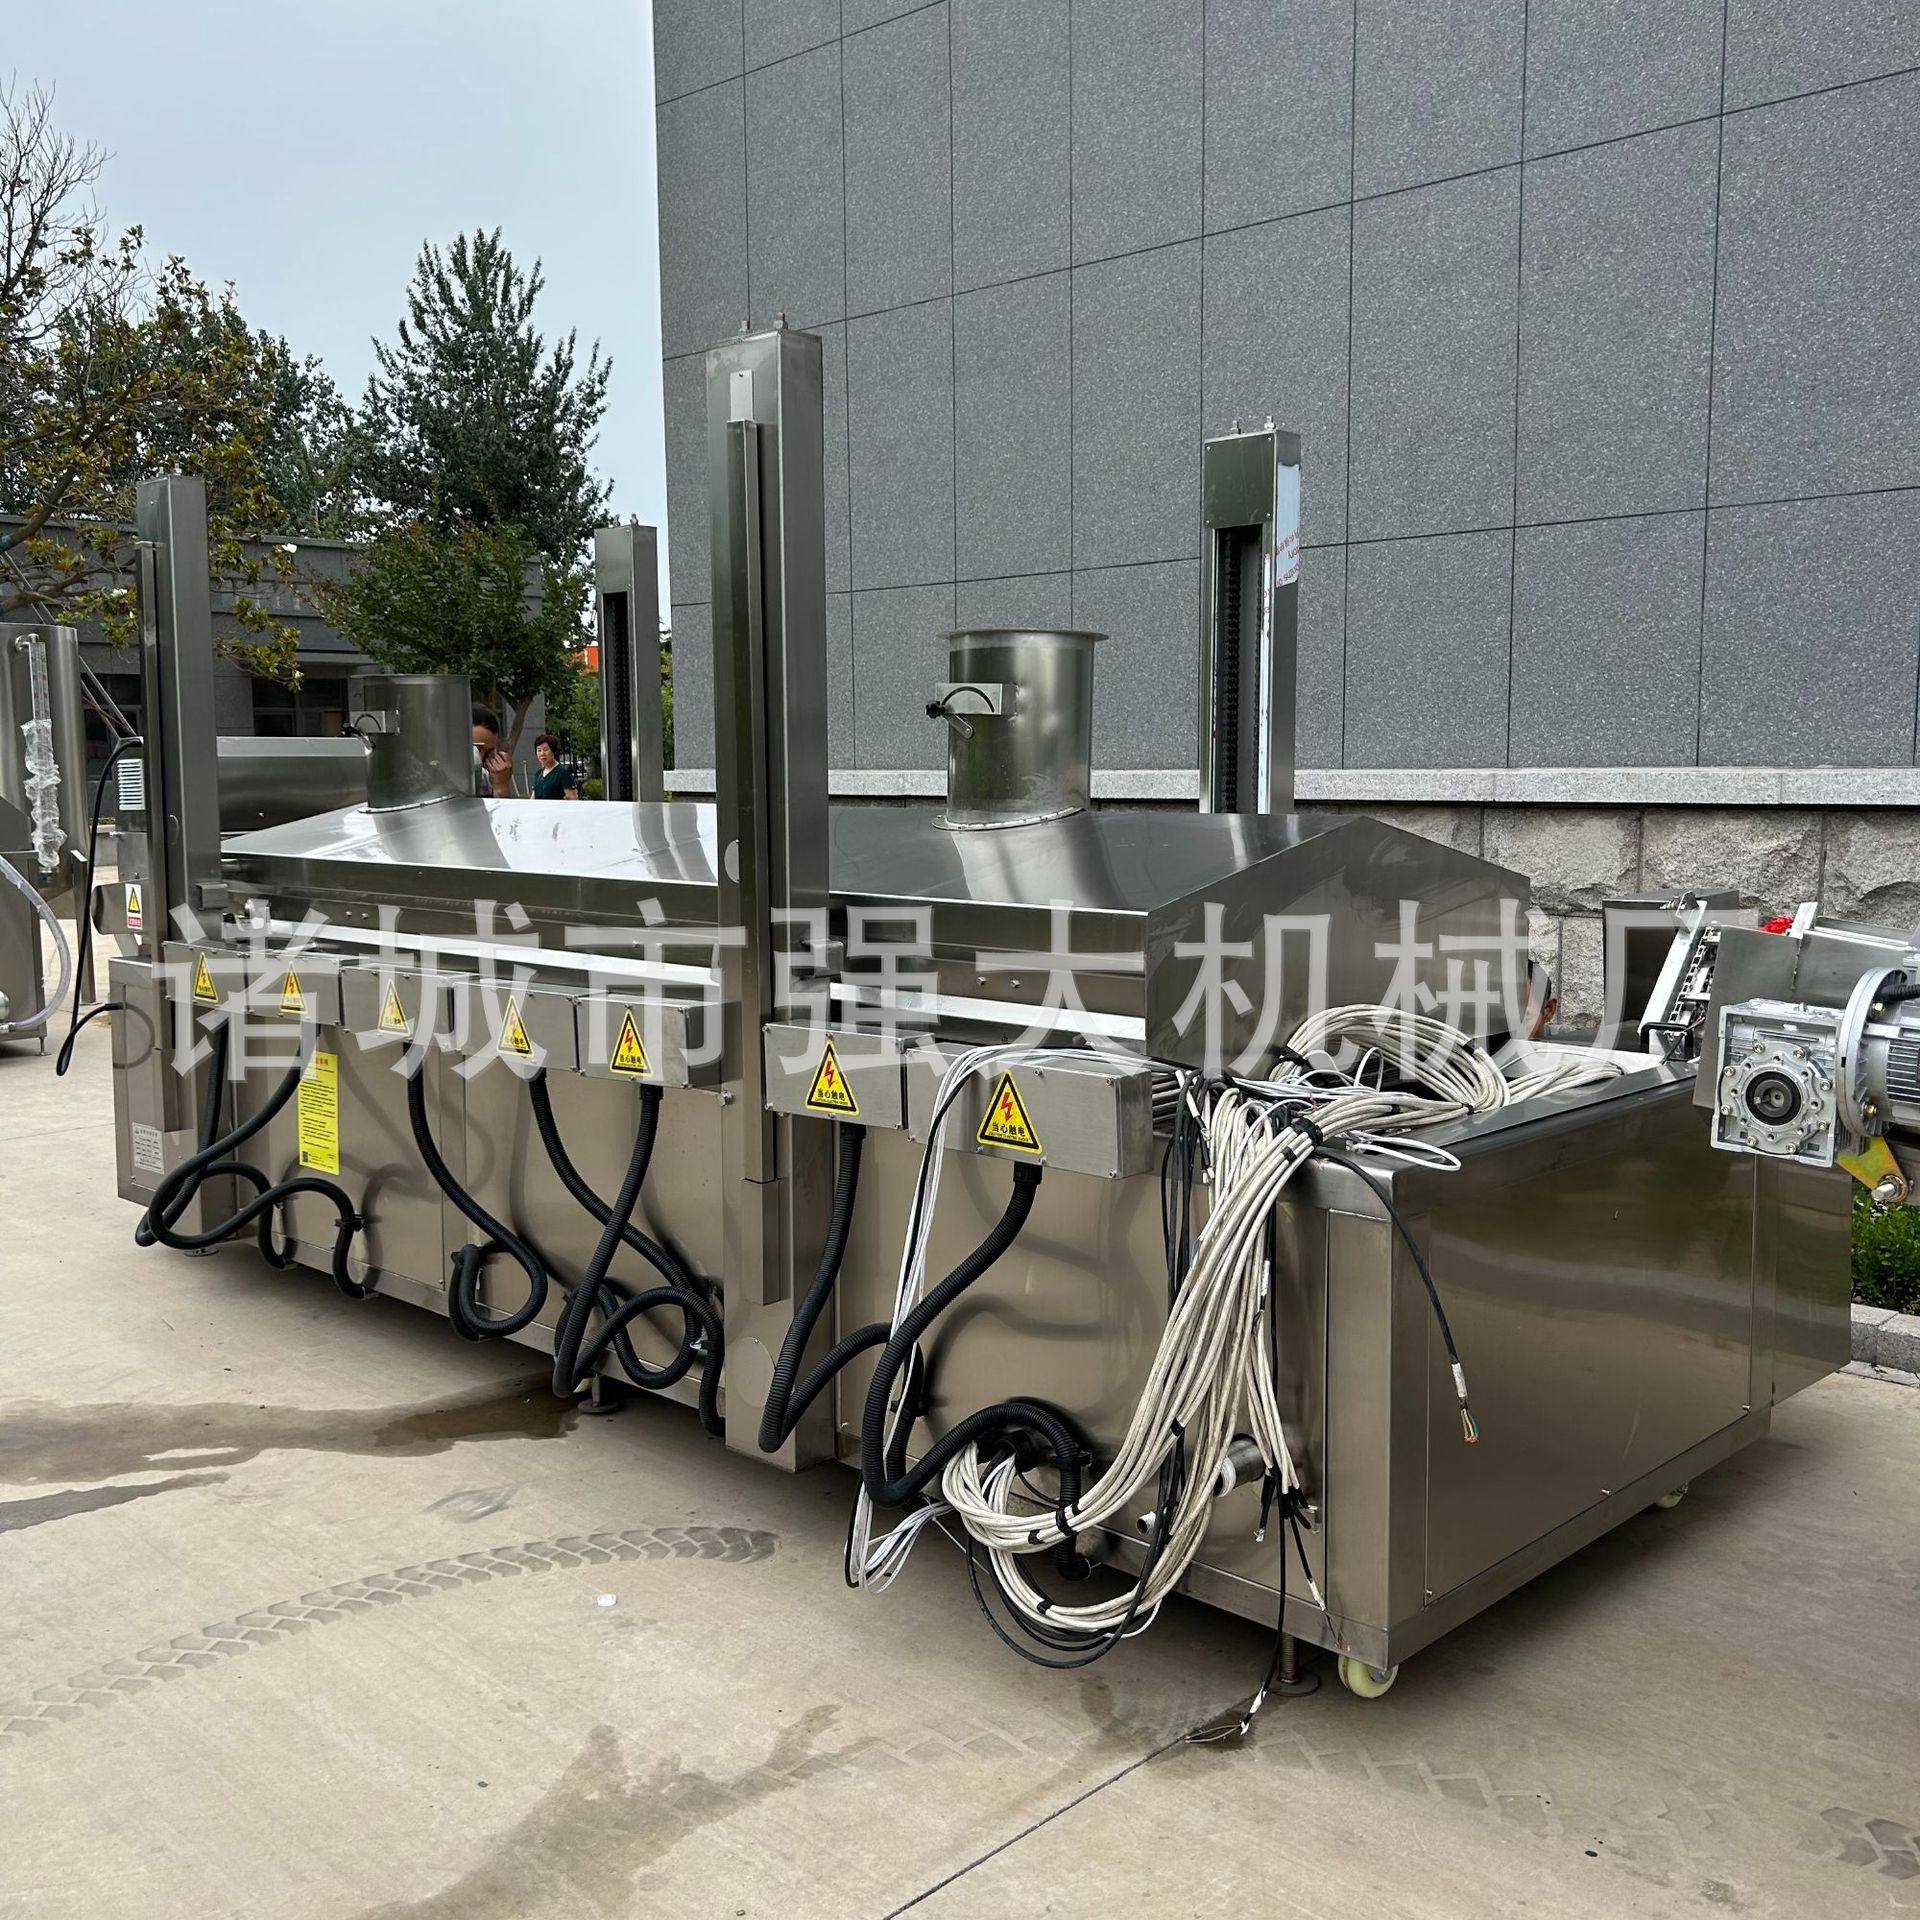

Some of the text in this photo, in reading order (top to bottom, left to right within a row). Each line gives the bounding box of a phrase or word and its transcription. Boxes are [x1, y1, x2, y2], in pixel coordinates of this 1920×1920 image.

[818, 1088, 845, 1101] 当心触电
[992, 1122, 1025, 1137] 当心触电
